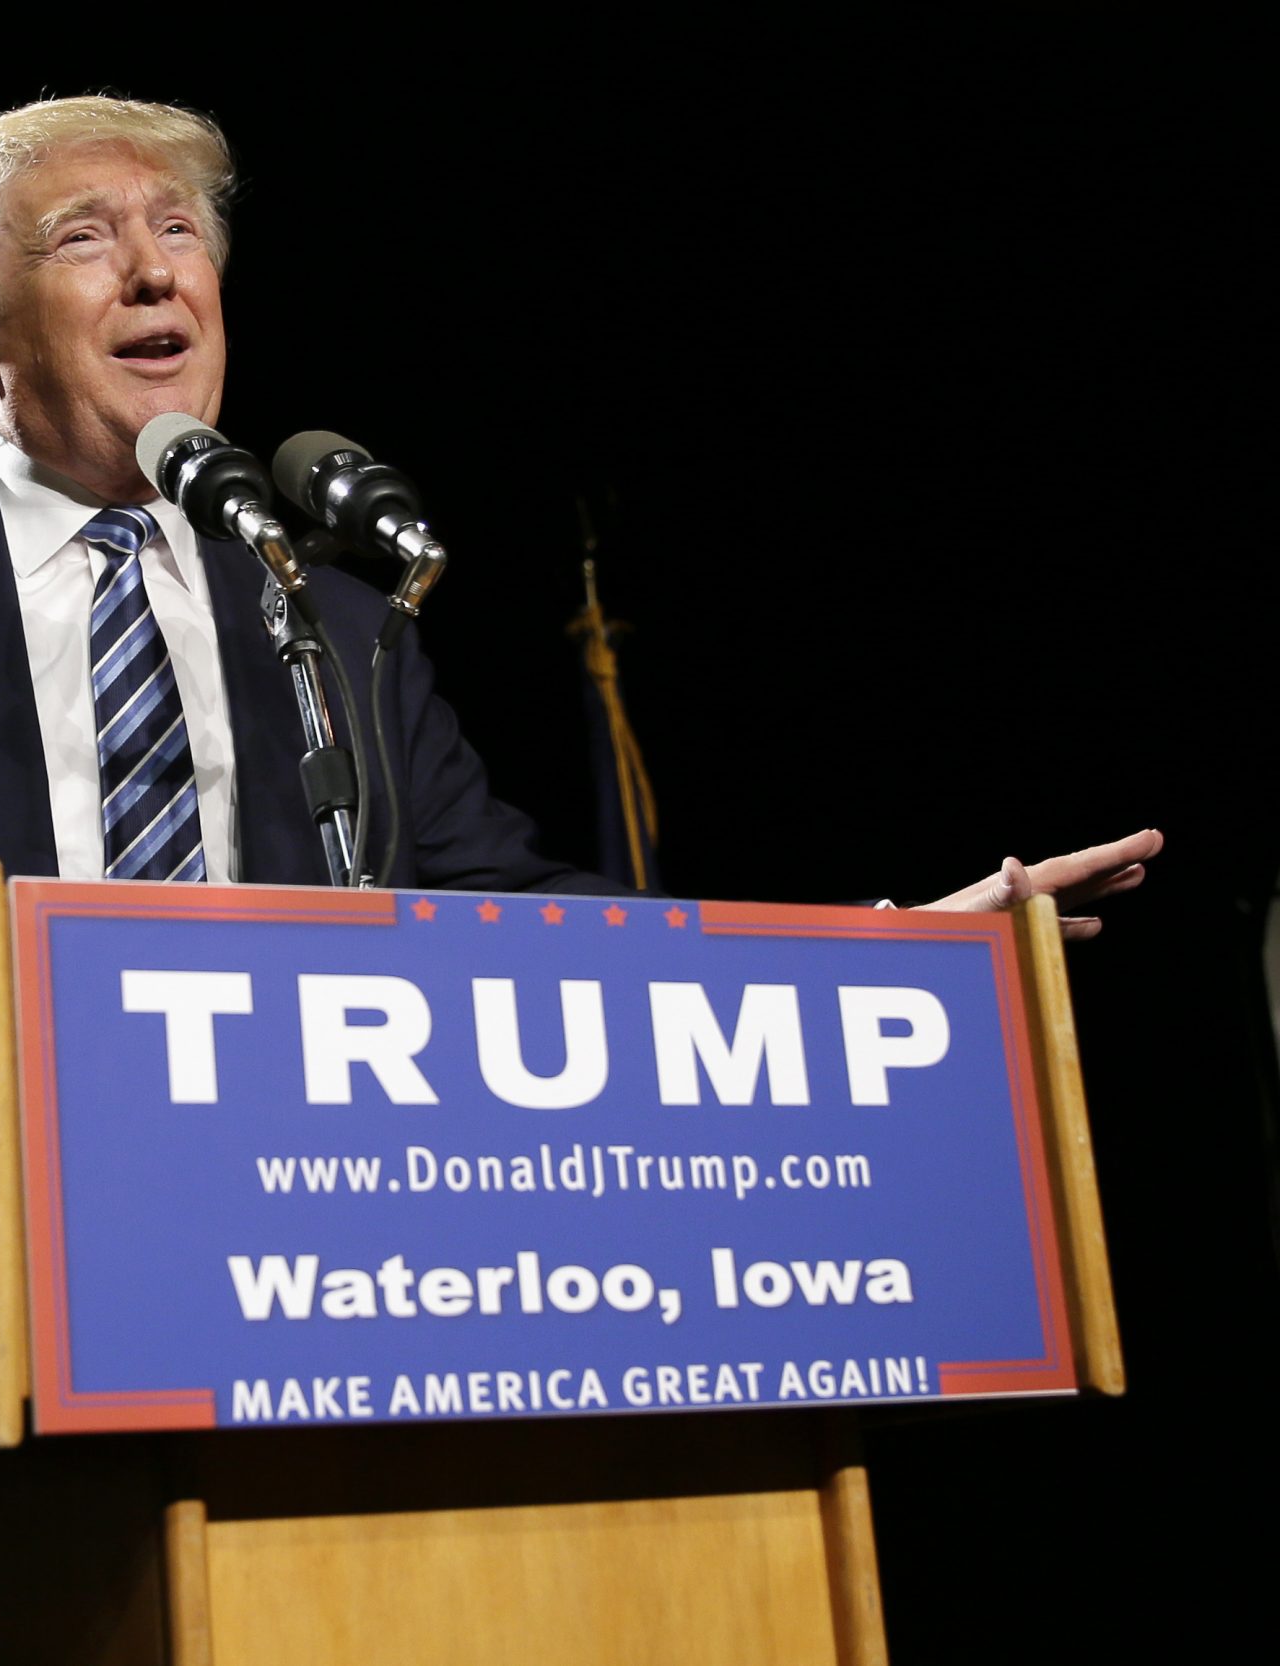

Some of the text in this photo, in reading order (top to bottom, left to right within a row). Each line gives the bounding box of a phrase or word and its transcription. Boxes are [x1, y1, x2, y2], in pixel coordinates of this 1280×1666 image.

[120, 968, 952, 1110] TRUMP
[256, 1142, 872, 1201] www.DonaldJTrump.com
[227, 1247, 914, 1324] Waterloo, Iowa
[231, 1355, 930, 1422] MAKE AMERICA GREAT AGAIN!
